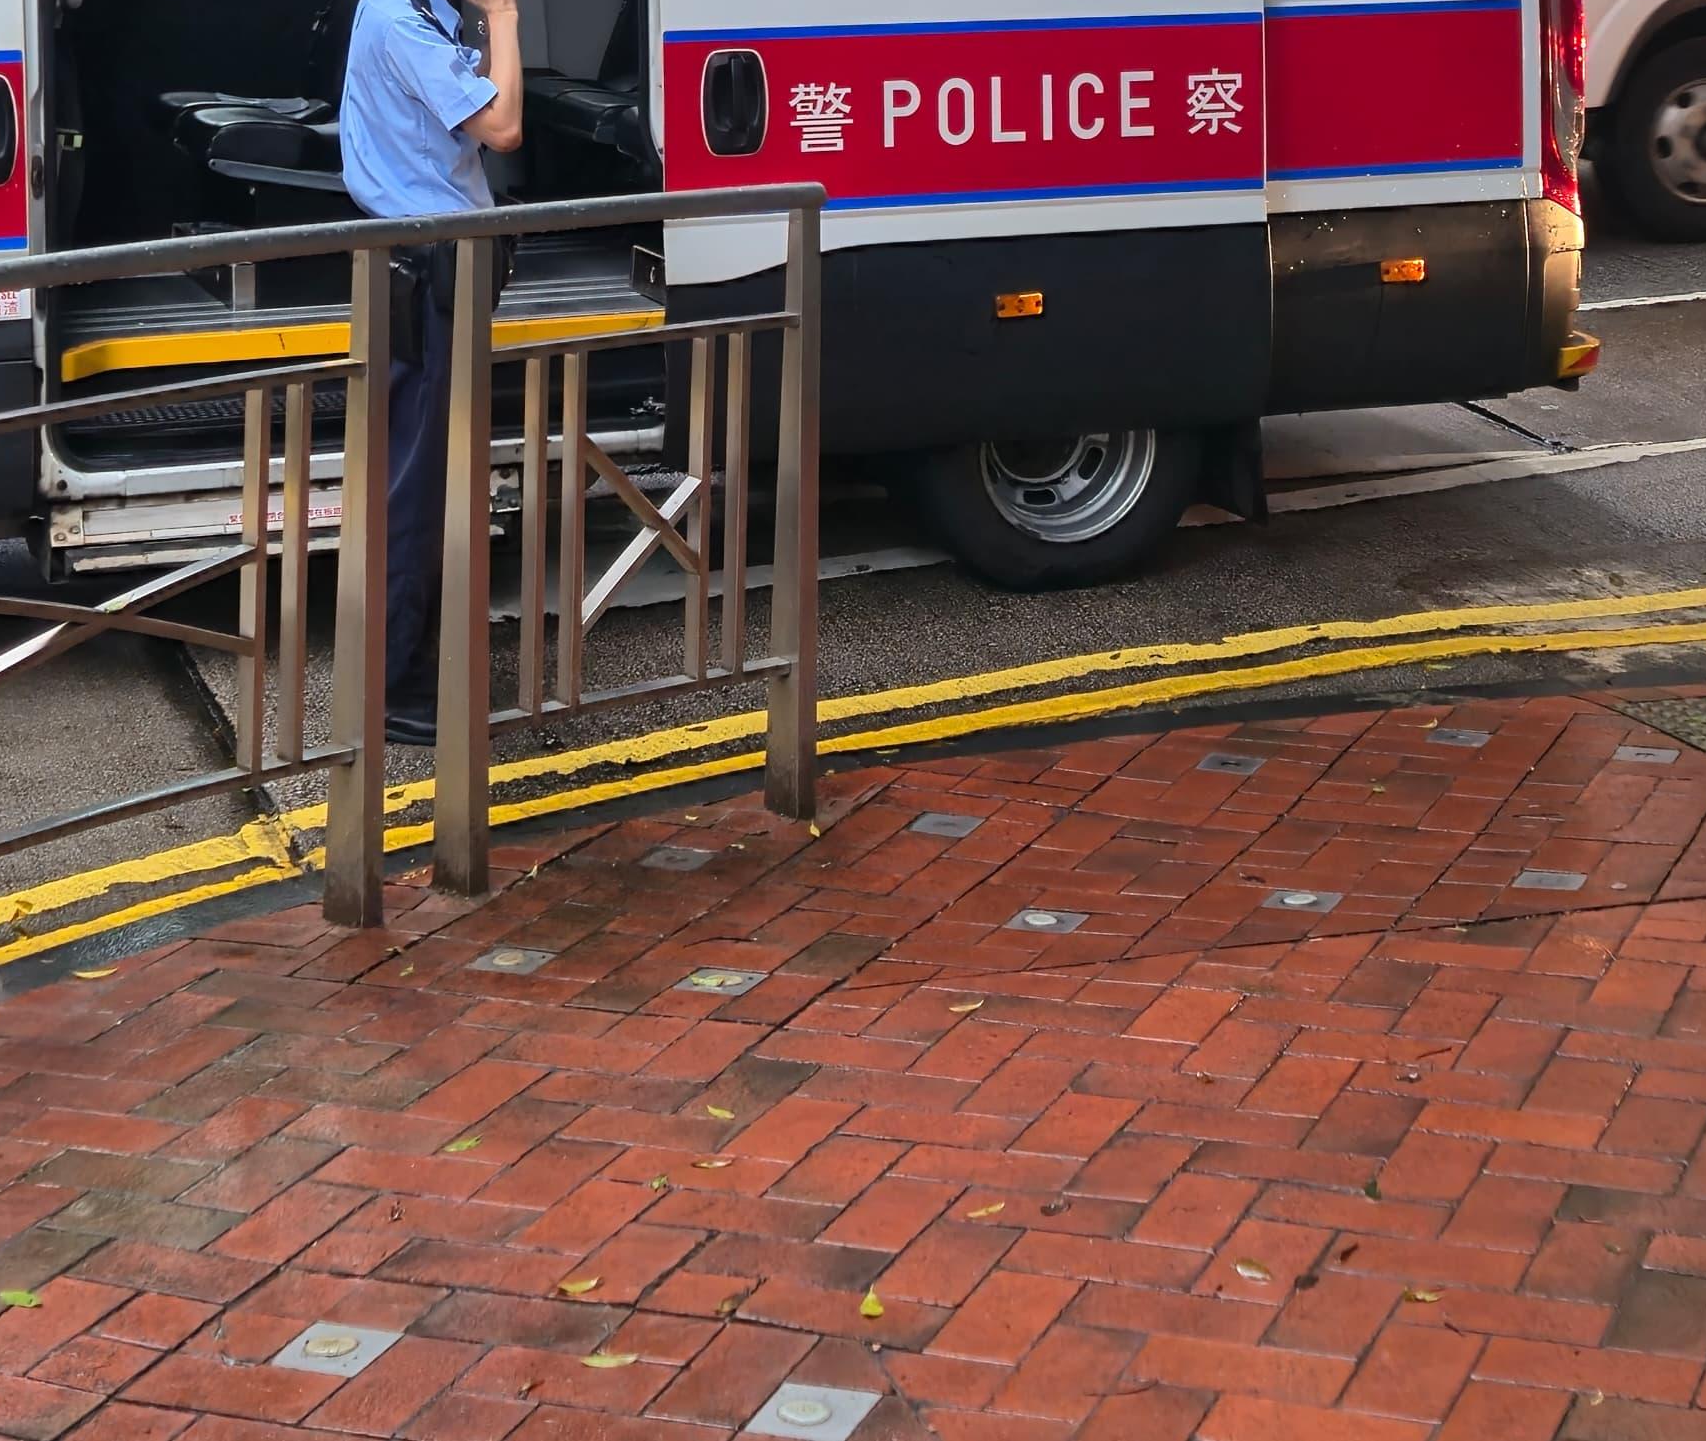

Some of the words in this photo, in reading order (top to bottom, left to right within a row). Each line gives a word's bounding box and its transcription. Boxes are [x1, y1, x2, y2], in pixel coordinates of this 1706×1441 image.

[788, 81, 854, 153] 警
[883, 70, 1155, 148] POLICE
[1186, 67, 1245, 136] 察
